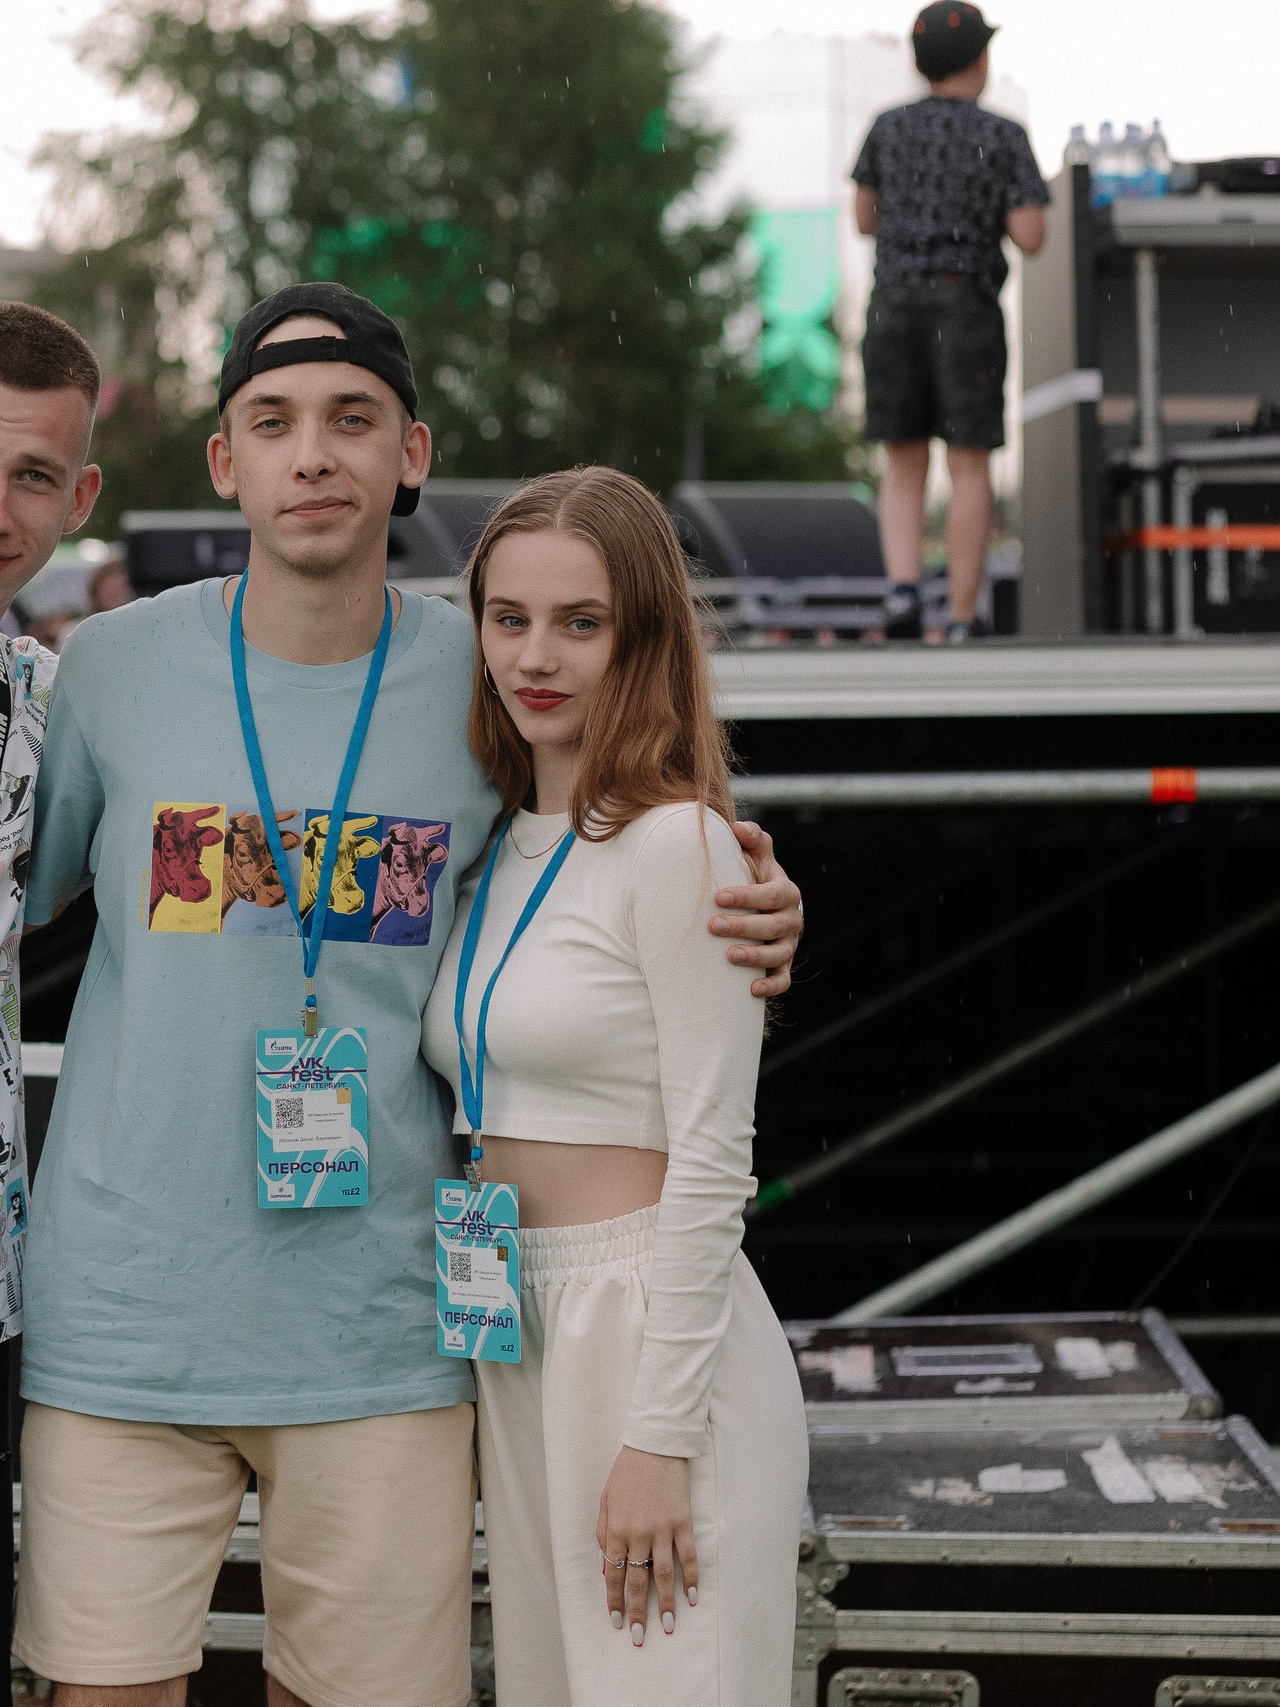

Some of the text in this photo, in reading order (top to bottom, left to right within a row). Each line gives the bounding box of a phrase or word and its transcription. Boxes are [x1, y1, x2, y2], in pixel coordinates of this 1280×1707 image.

[298, 1057, 324, 1069] VK
[291, 1066, 334, 1082] fest
[276, 1081, 347, 1090] САНКТ-ПЕТЕРБУРГ
[268, 1160, 359, 1175] ПЕРСОНАЛ
[342, 1187, 360, 1196] TELE2
[467, 1210, 486, 1222] VK
[462, 1218, 493, 1236] fest
[450, 1234, 504, 1244] САНКТ-ПЕТЕРБУРГ
[445, 1311, 513, 1329] ПЕРСОНАЛ
